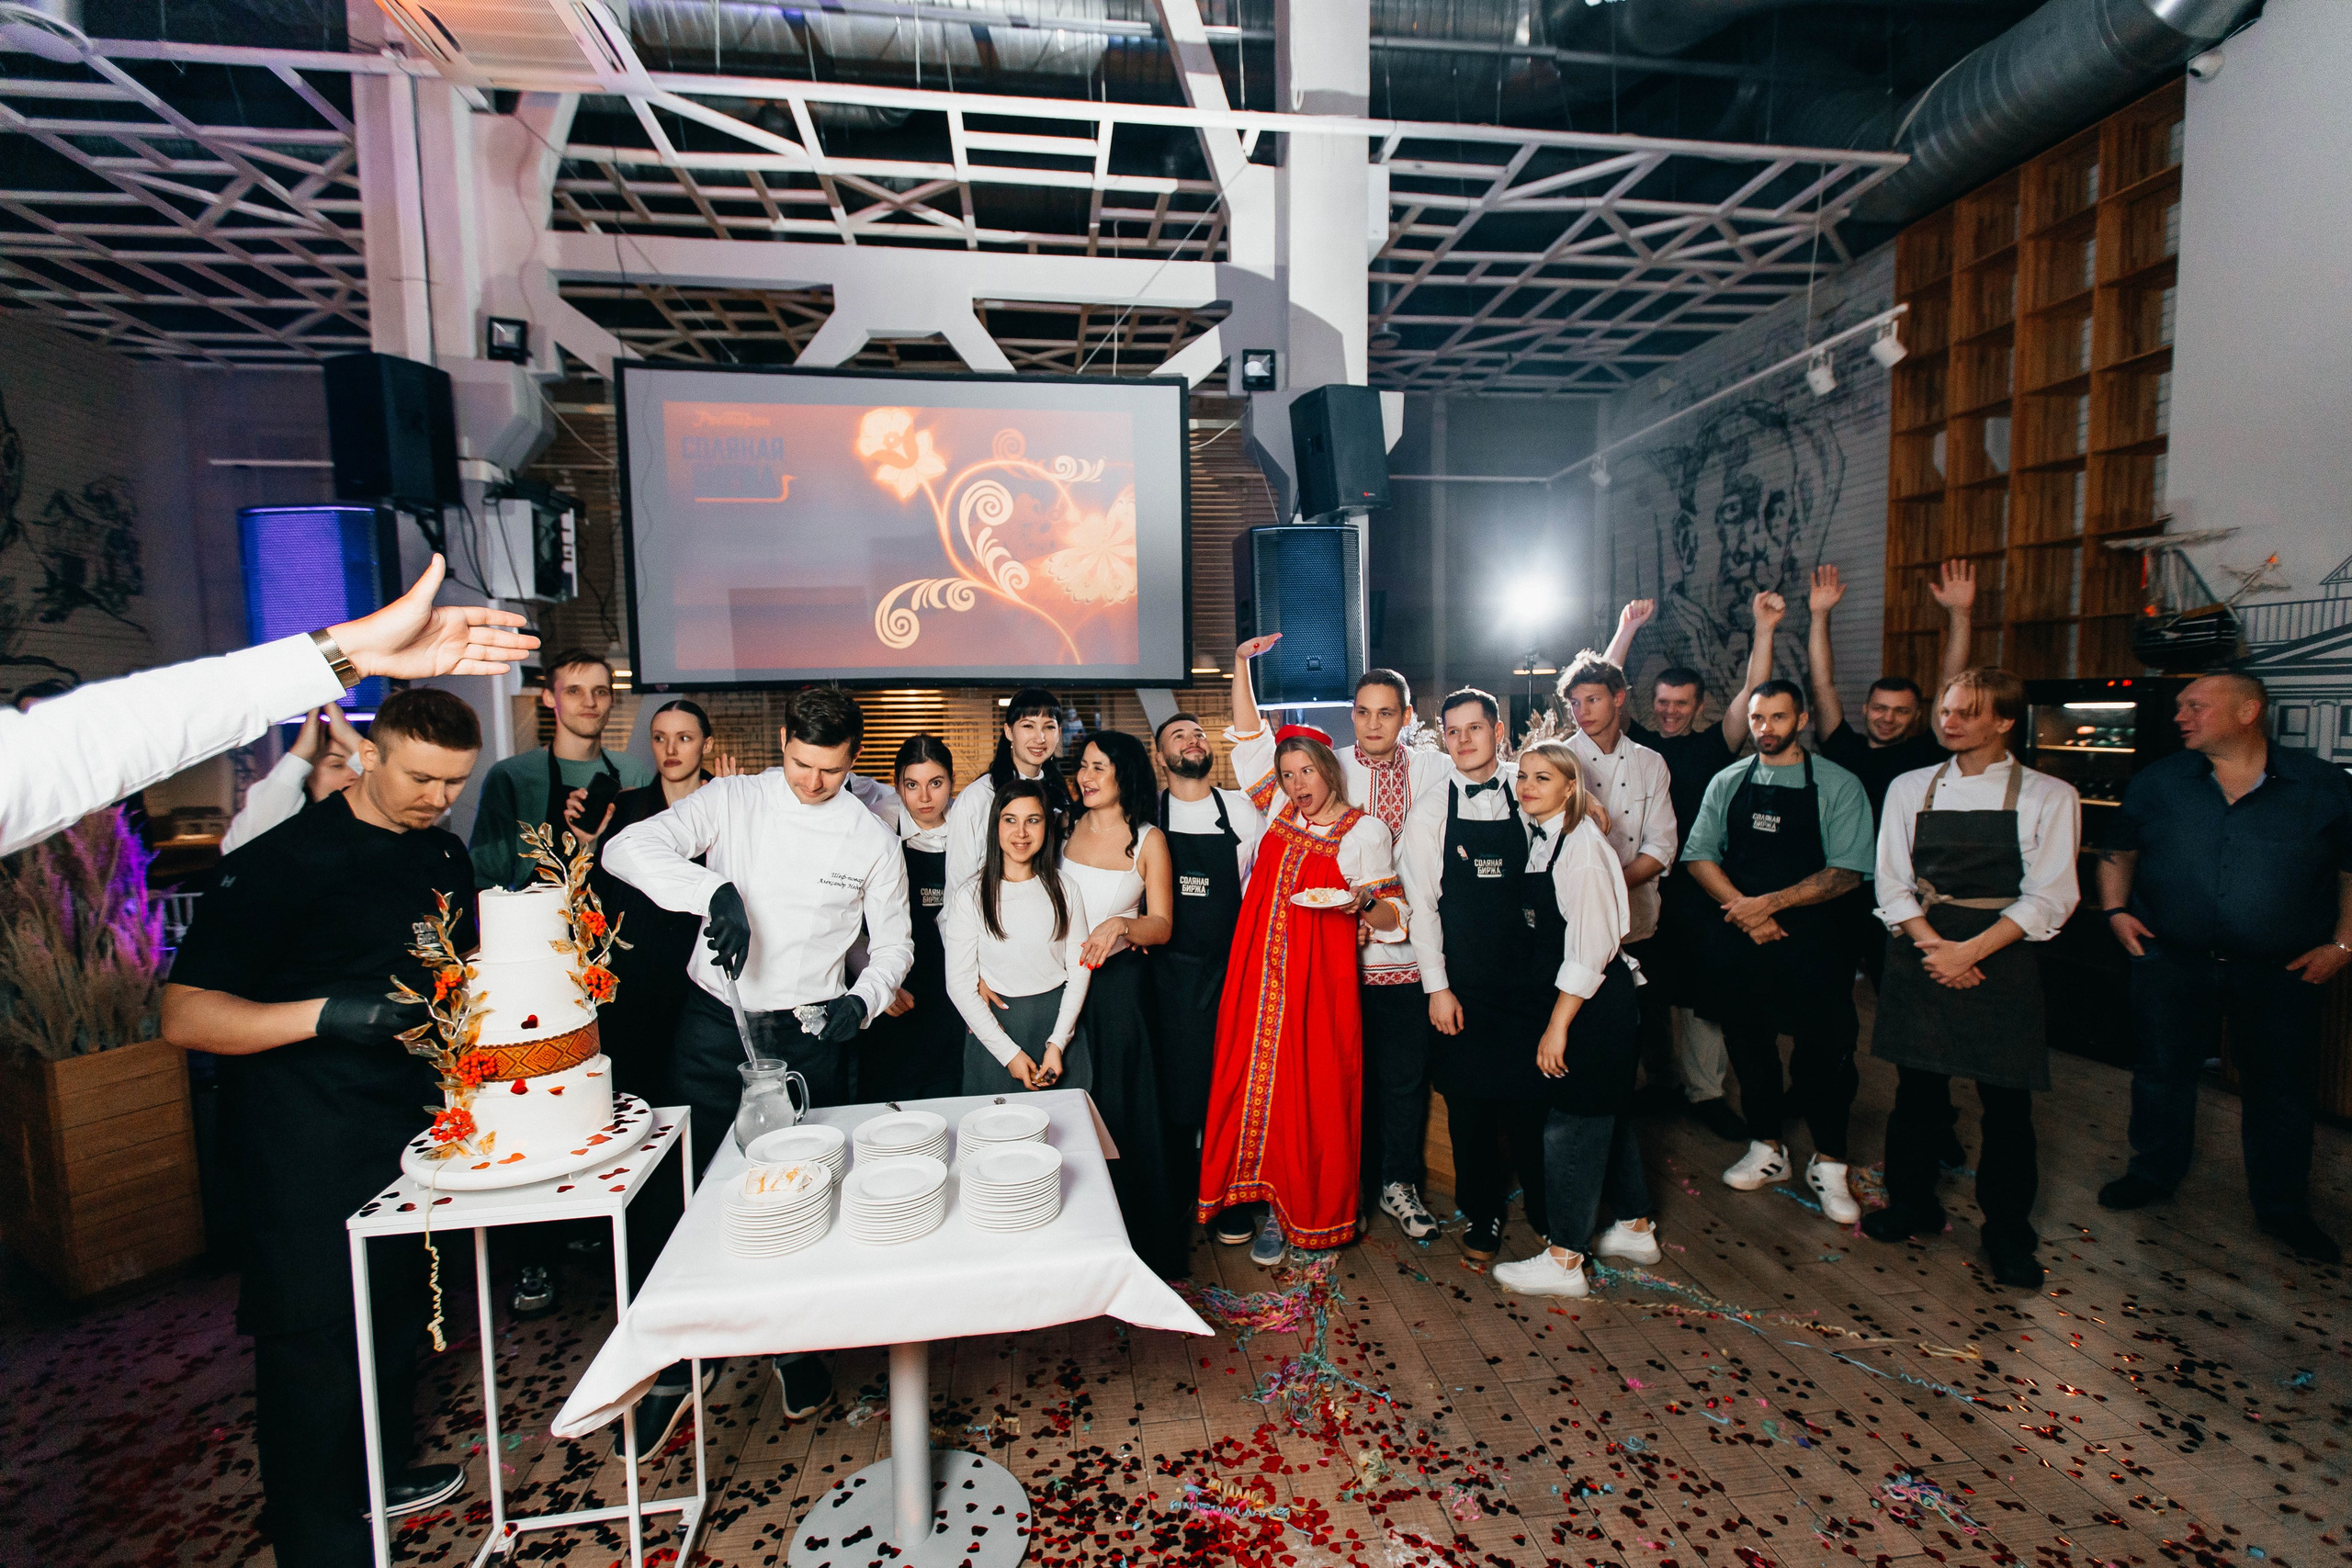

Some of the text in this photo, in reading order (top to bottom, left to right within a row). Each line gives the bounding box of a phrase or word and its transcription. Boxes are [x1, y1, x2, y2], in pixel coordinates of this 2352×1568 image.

[1474, 858, 1502, 867] СОЛЯНАЯ
[1477, 866, 1502, 874] БИРЖА
[1180, 875, 1209, 886] СОЛЯНАЯ
[920, 887, 944, 897] СОЛЯНА
[1182, 884, 1206, 894] БИРЖА
